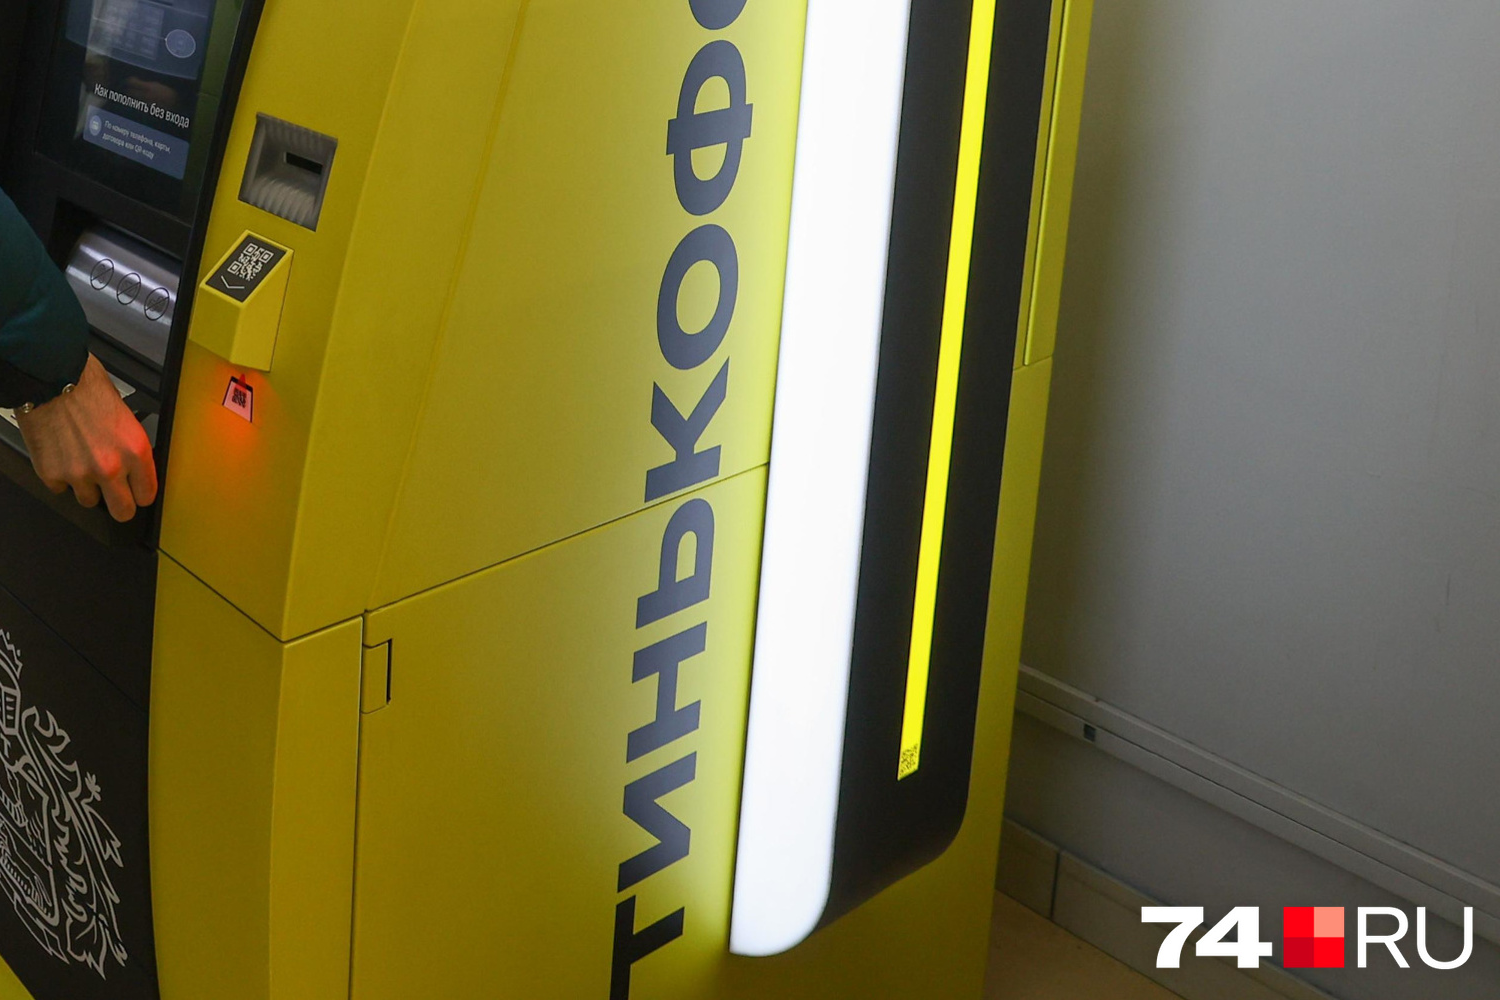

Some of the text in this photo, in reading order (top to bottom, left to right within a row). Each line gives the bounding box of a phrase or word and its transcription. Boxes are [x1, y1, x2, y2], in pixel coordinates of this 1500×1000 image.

[94, 84, 190, 128] Как пополнить без входа
